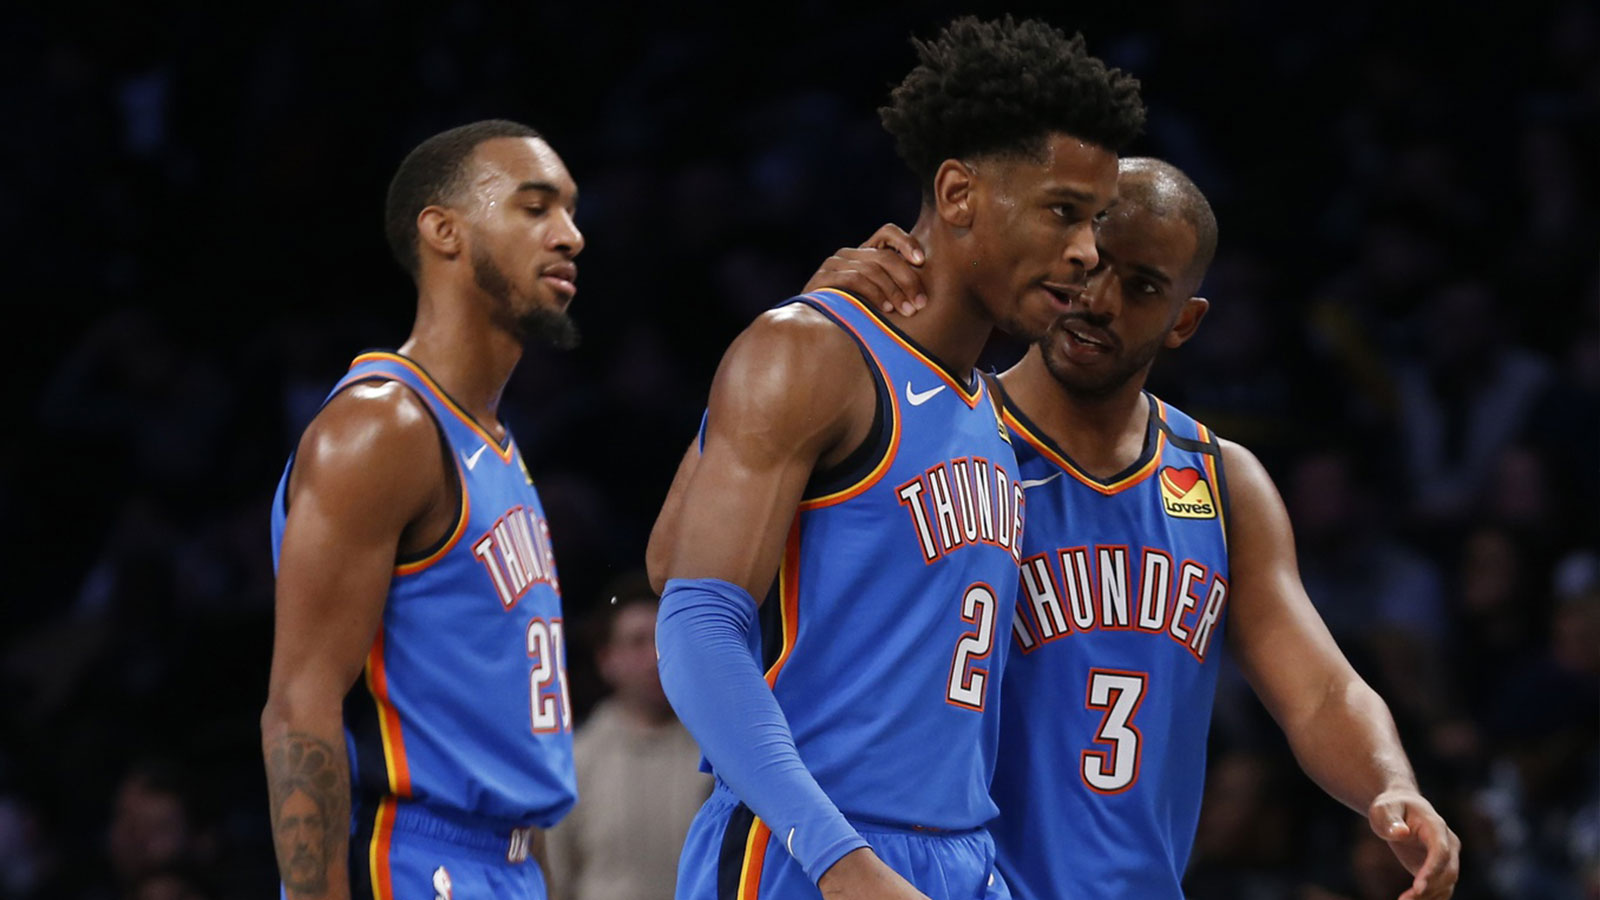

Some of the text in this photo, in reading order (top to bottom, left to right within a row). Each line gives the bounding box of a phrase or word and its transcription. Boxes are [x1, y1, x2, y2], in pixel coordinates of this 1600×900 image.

[895, 456, 1025, 565] THUNDE
[945, 581, 996, 711] 2
[1080, 667, 1148, 795] 3
